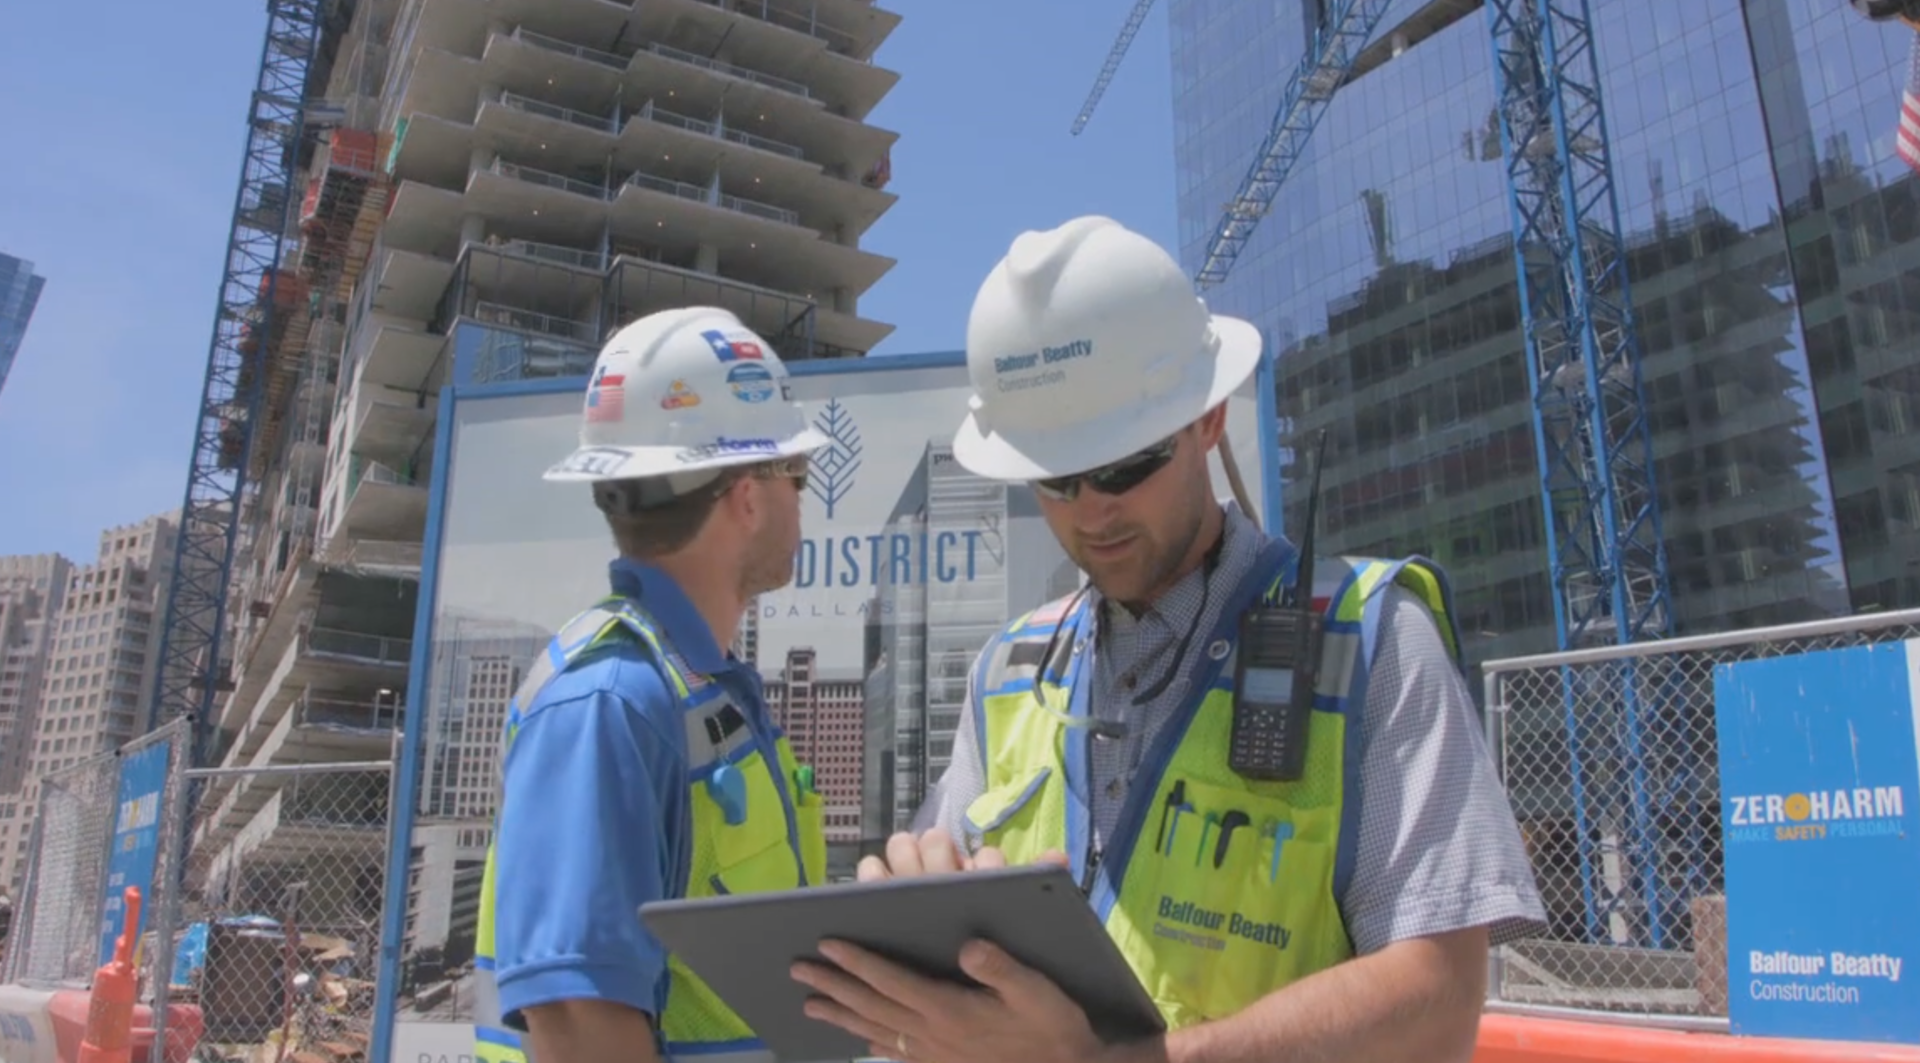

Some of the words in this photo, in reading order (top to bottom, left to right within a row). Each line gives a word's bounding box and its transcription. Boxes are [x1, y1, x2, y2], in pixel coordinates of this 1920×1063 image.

[994, 353, 1038, 374] Balfour
[1042, 339, 1093, 364] Beatty
[998, 370, 1066, 393] Construction
[794, 530, 982, 589] DISTRICT
[763, 602, 895, 619] DALLAS
[1731, 825, 1770, 843] MAKE
[1775, 823, 1826, 841] SAFETY
[1830, 819, 1902, 838] PERSONAL
[1153, 922, 1226, 952] Construction
[1158, 895, 1225, 931] Balfour
[1228, 912, 1292, 951] Beatty
[1750, 950, 1825, 976] Balfour
[1831, 952, 1902, 982] Beatty
[1750, 979, 1860, 1003] Construction
